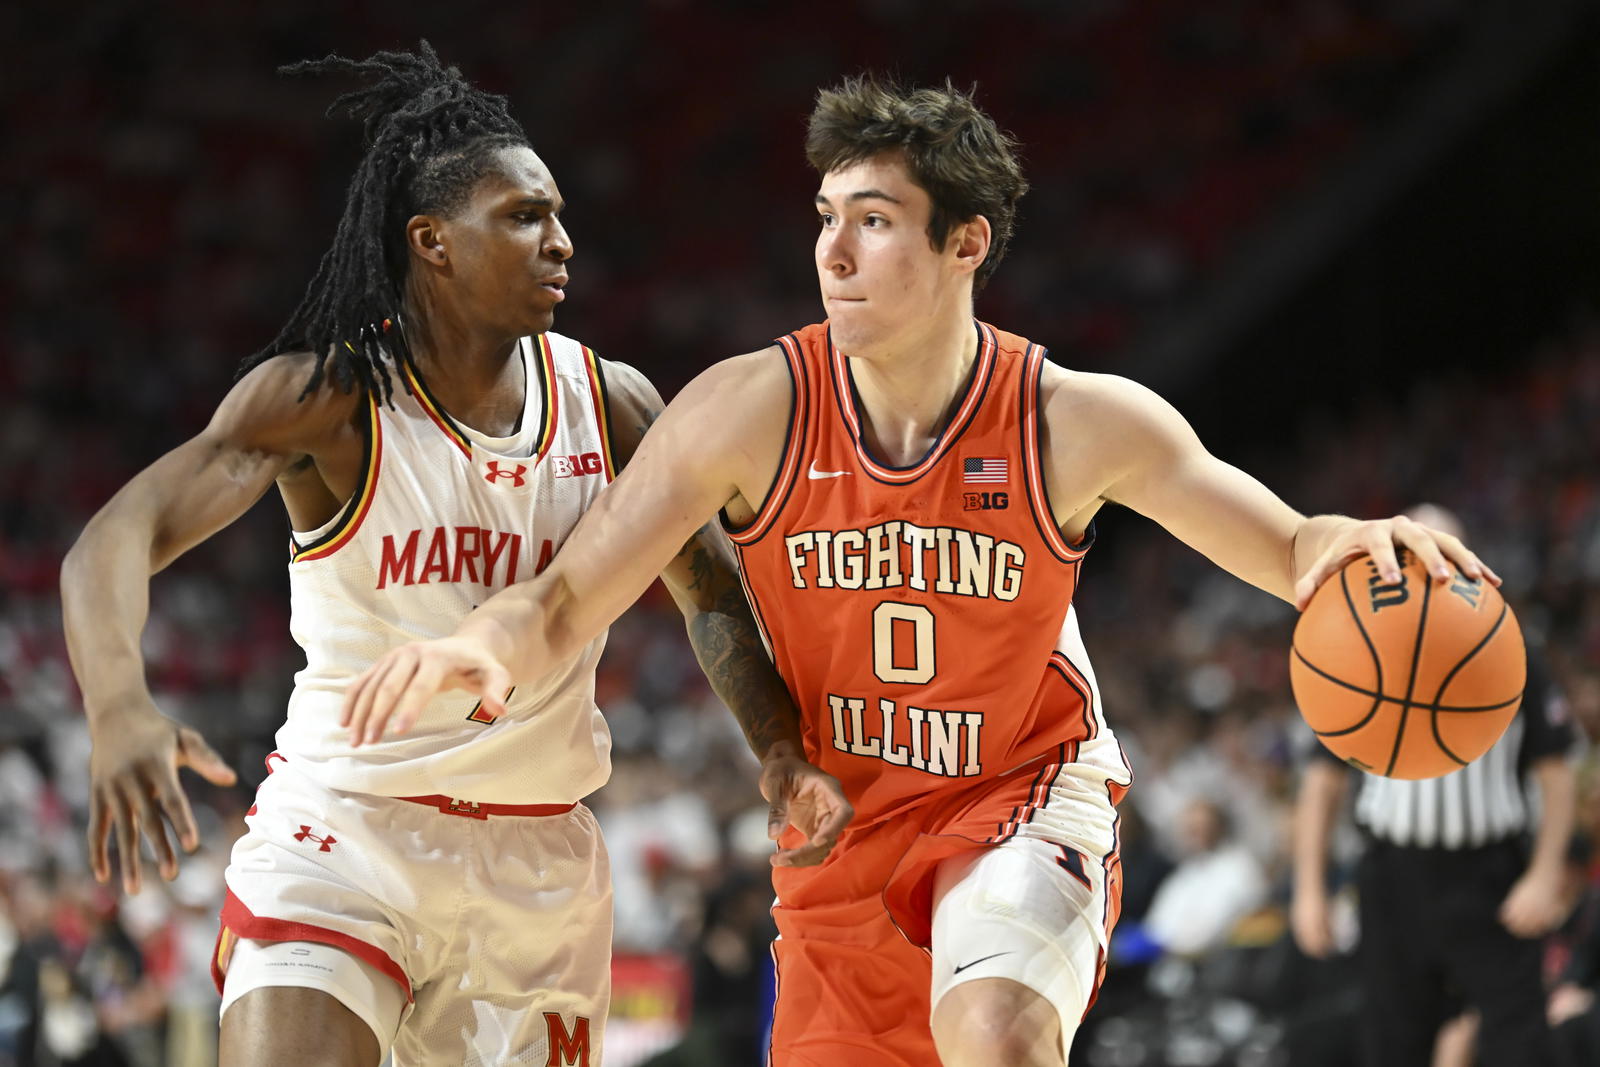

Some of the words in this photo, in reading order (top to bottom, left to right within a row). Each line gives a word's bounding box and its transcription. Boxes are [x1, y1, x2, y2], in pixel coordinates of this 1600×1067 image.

[784, 519, 1026, 602] FIGHTING
[872, 600, 936, 685] 0
[827, 693, 984, 778] ILLINI
[542, 1011, 592, 1067] M
